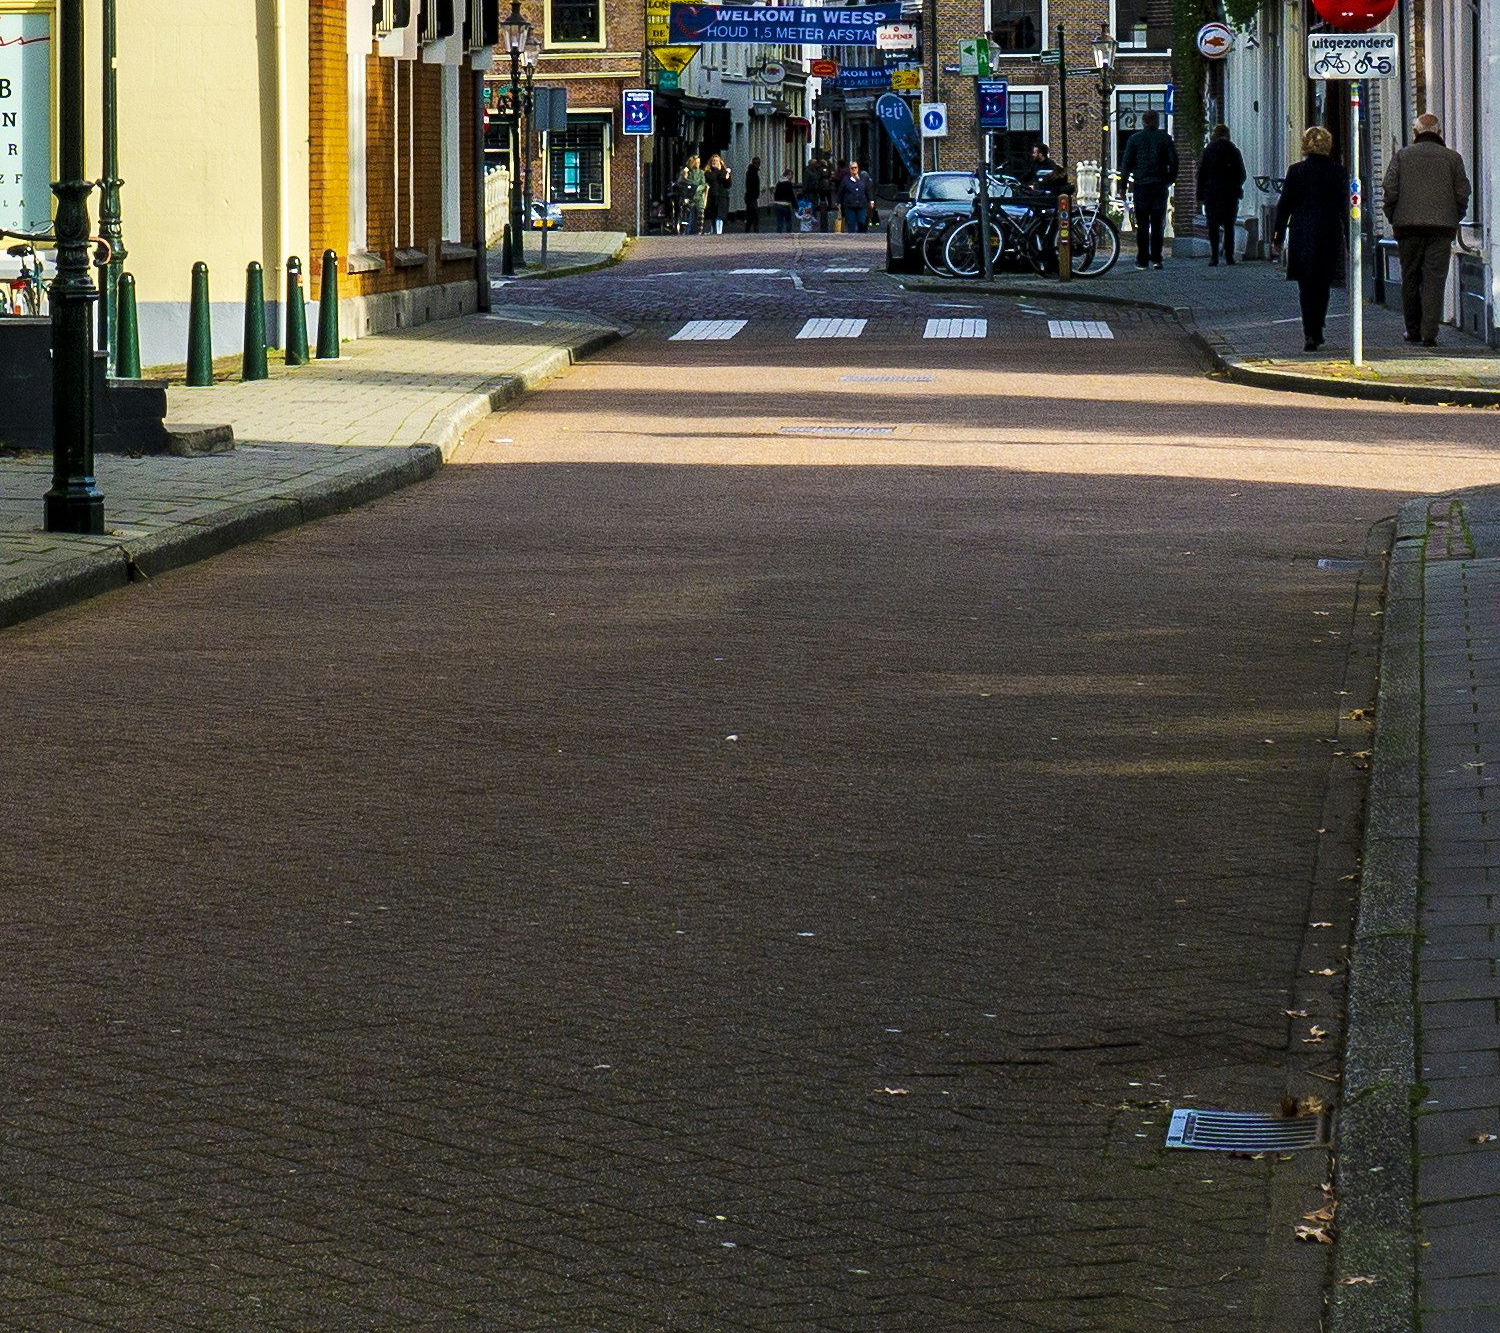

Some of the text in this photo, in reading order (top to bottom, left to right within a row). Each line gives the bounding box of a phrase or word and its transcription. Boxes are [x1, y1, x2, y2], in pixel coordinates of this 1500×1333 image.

[716, 10, 886, 25] WELKOM in WEESP
[707, 25, 877, 41] HOUD 1,5 METER AFSTAN
[1312, 37, 1394, 52] uitgezonderd
